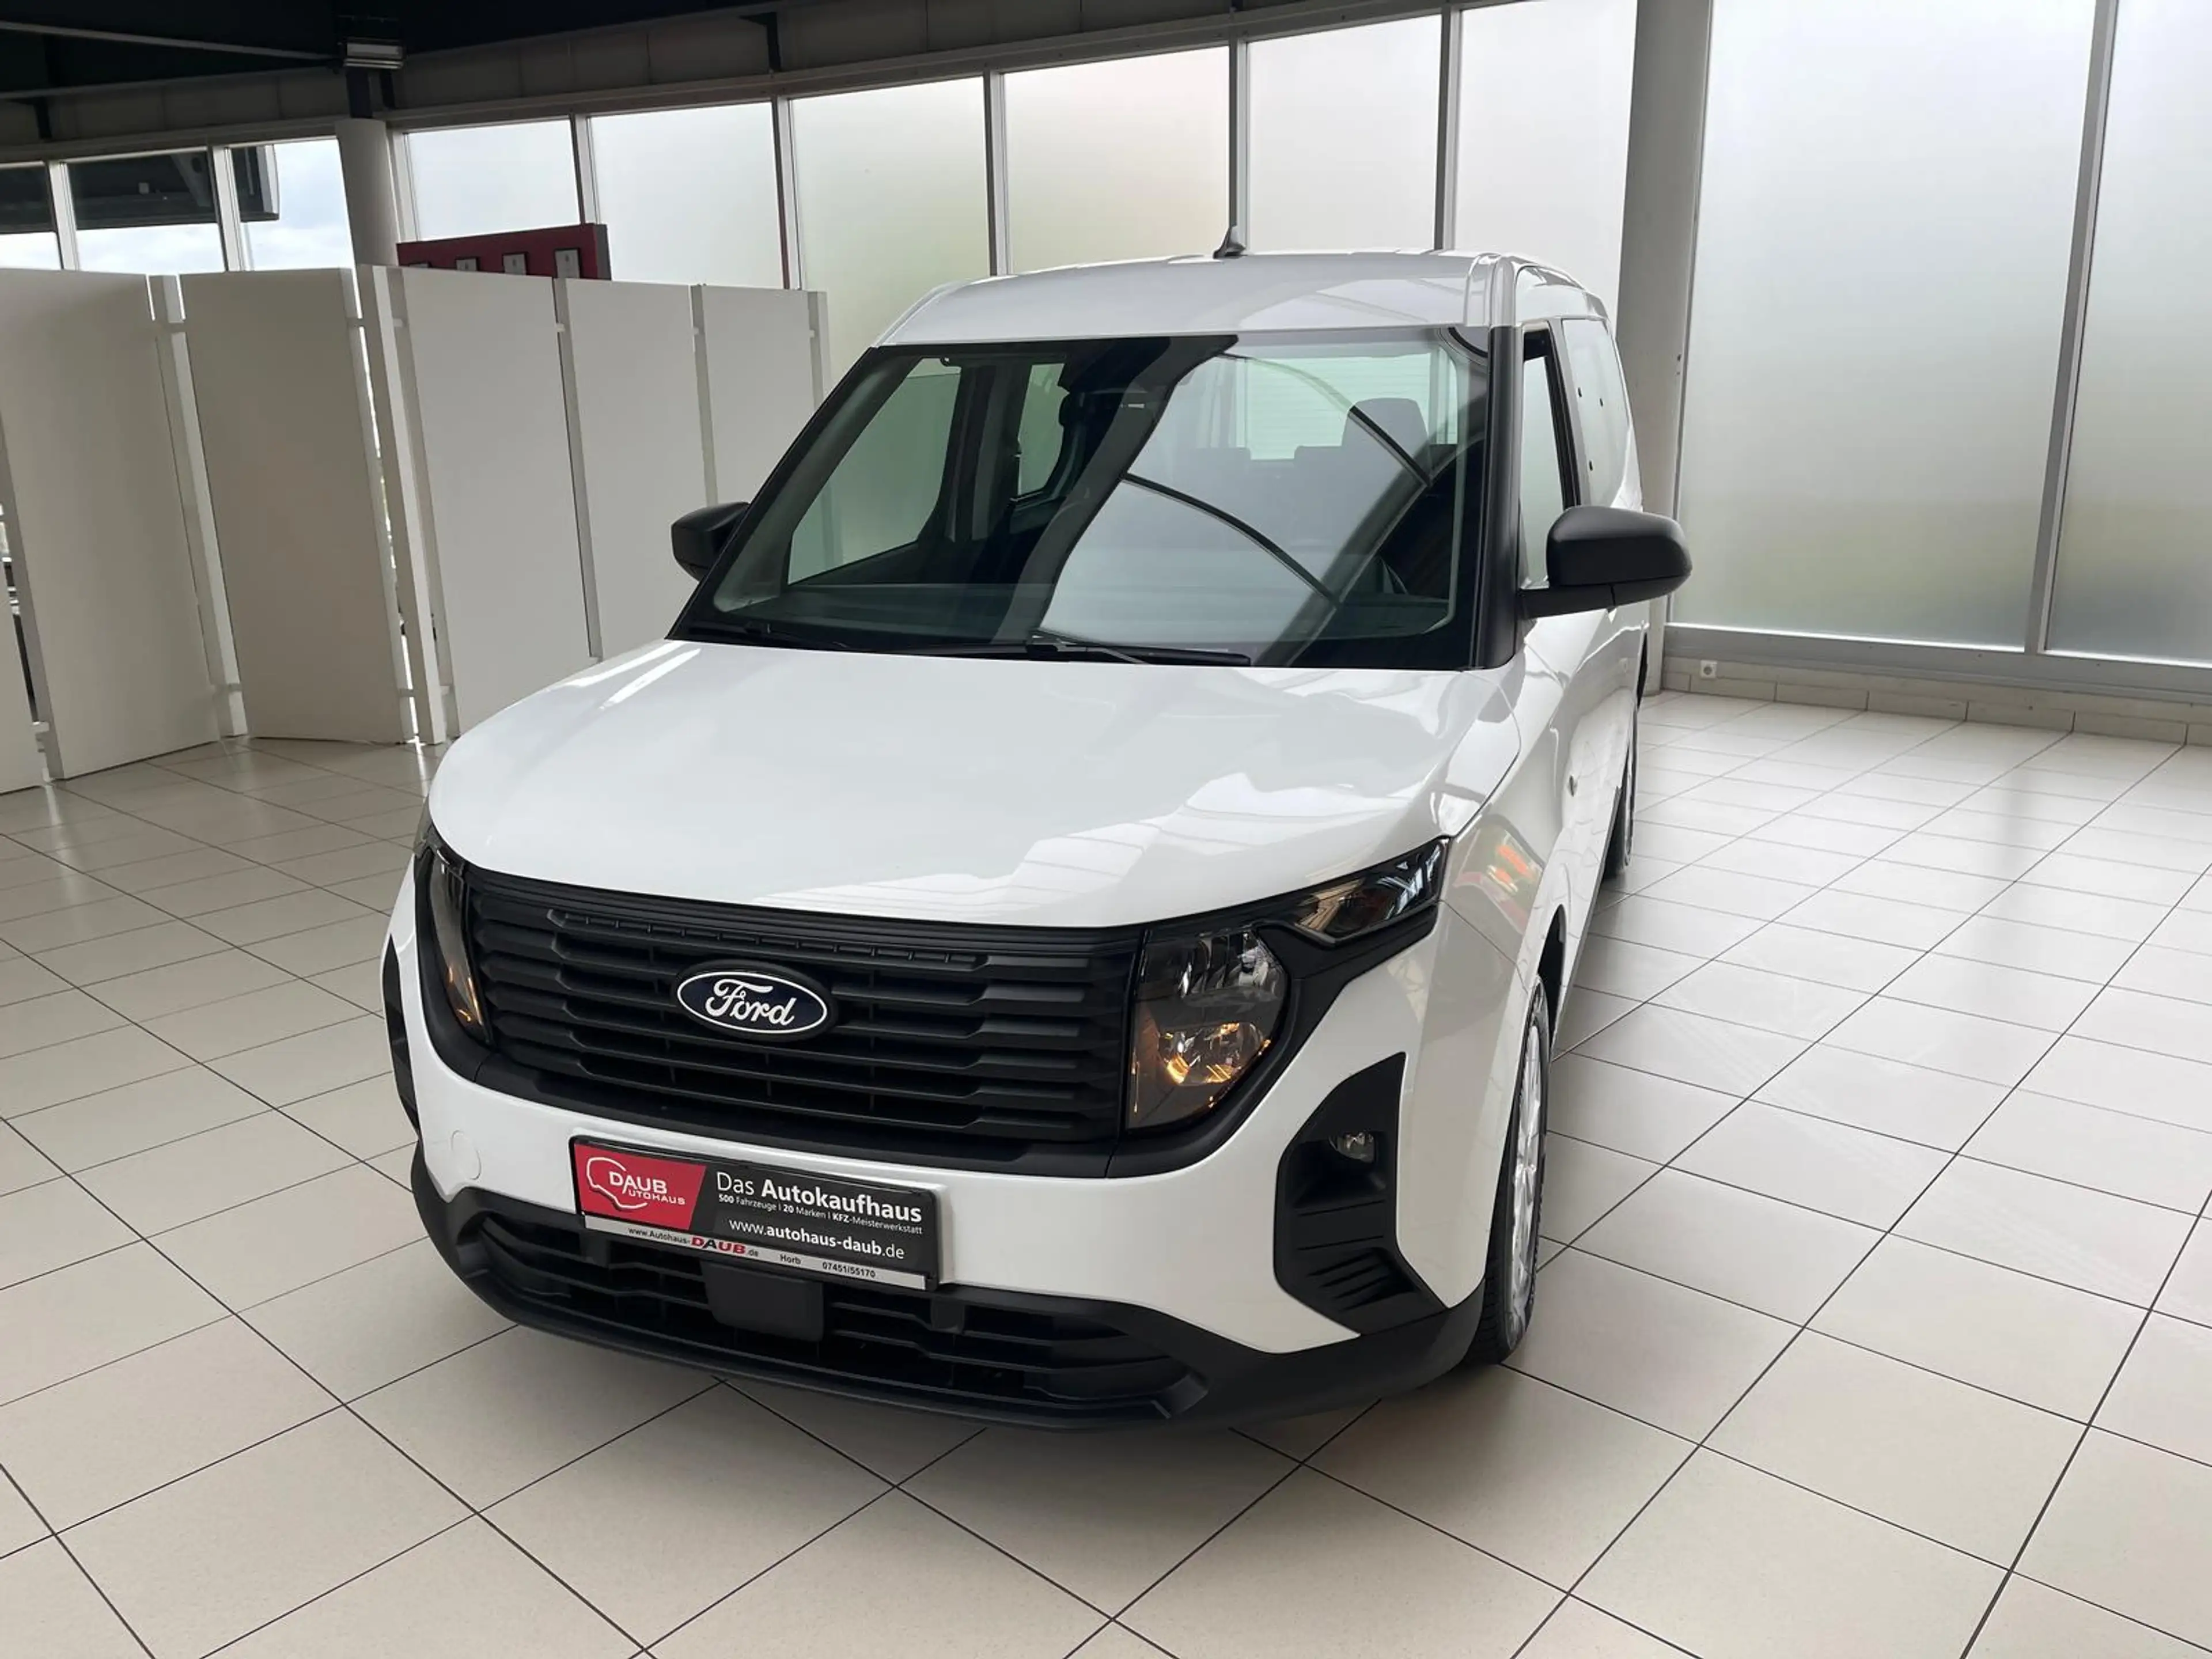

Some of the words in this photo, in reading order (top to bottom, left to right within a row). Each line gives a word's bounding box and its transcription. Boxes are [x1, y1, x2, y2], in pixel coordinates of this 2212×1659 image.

[706, 979, 797, 1026] Ford
[609, 1171, 668, 1194] DAUB
[717, 1172, 755, 1195] Das
[761, 1179, 922, 1222] Autokaufhaus
[718, 1194, 735, 1204] 500
[736, 1196, 777, 1212] Fahrzeuge
[783, 1204, 794, 1213] 20
[796, 1206, 827, 1218] Marken
[832, 1212, 923, 1234] KFZ-Meisterwerkstatt
[729, 1219, 905, 1259] www.autohaus-daub.de
[779, 1253, 801, 1265] Horb
